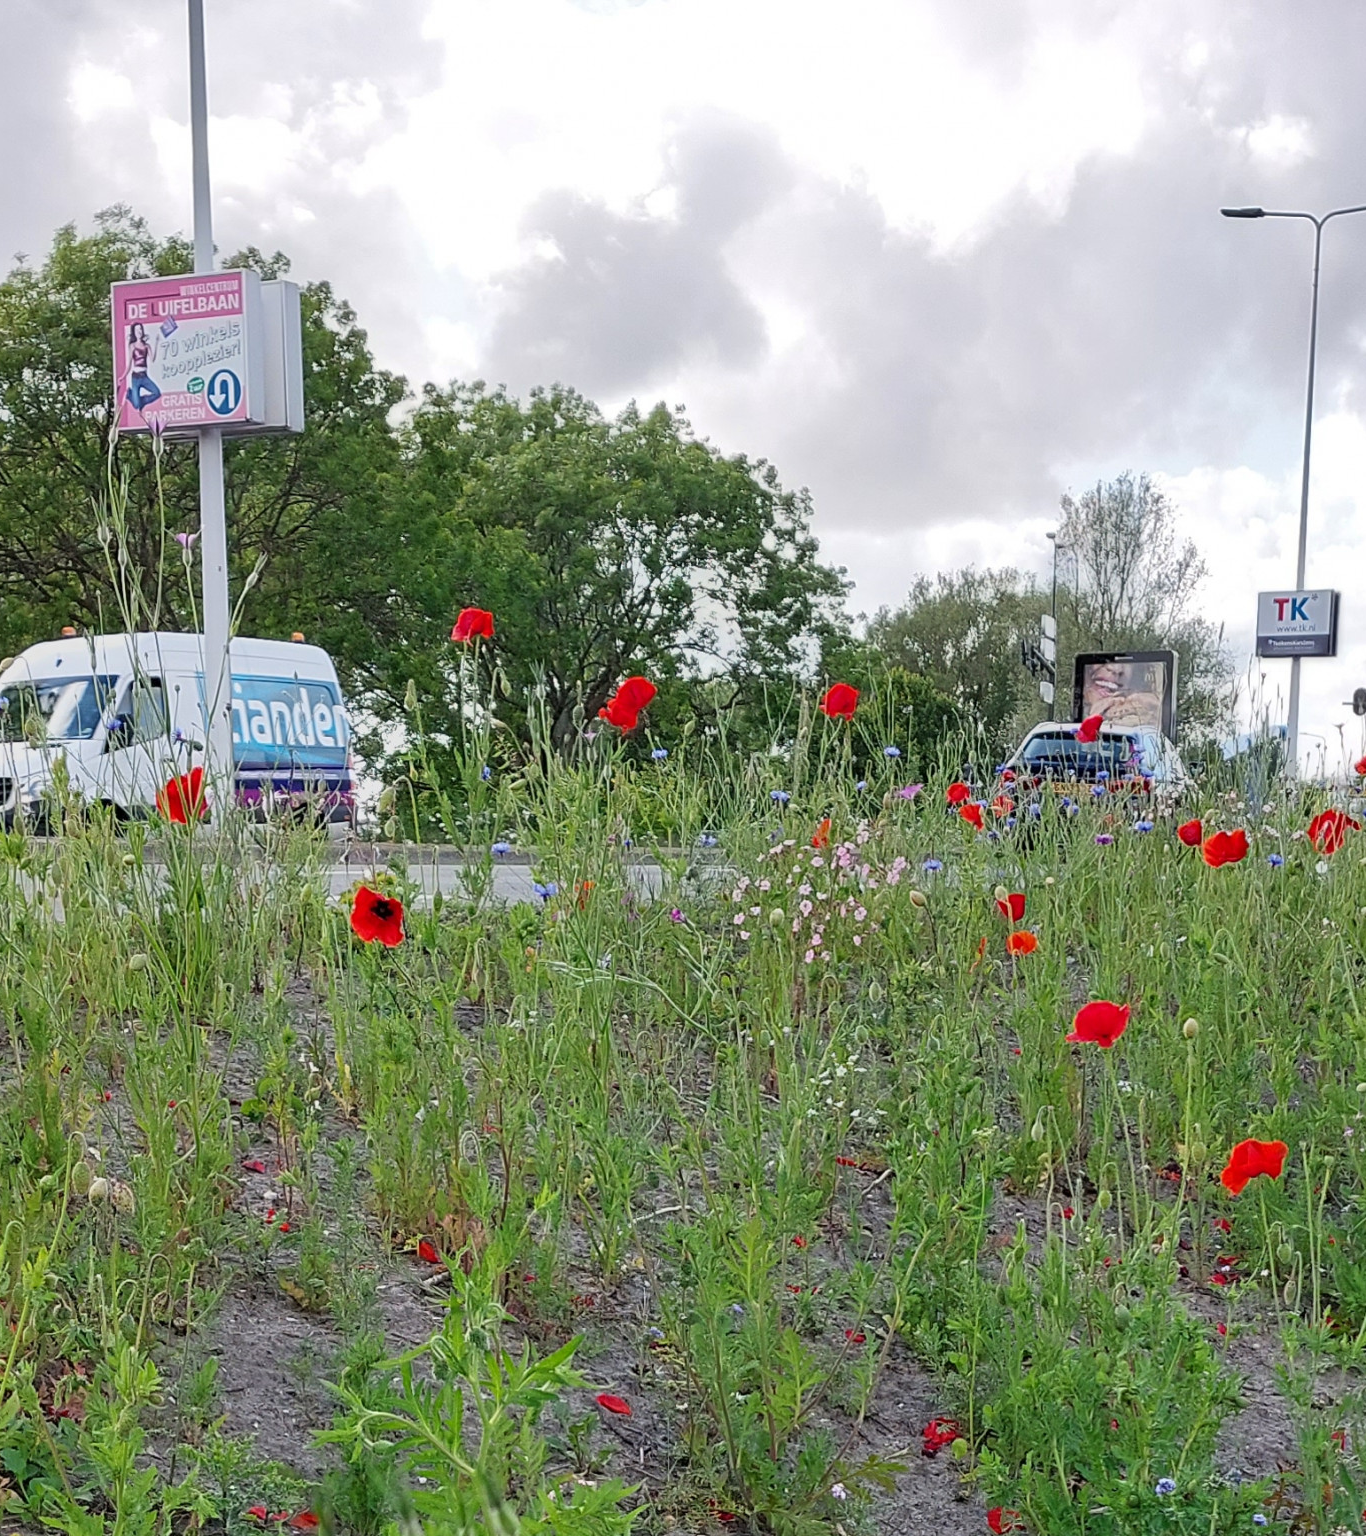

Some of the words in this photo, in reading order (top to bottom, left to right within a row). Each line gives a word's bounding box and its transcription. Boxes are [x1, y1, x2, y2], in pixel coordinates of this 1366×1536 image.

[128, 304, 147, 319] DE
[160, 339, 178, 360] 70
[182, 320, 240, 353] winkels
[162, 393, 202, 407] GRATIS
[145, 407, 205, 421] PARKEREN
[1273, 597, 1309, 621] TK
[1276, 623, 1316, 632] www.tk.nl
